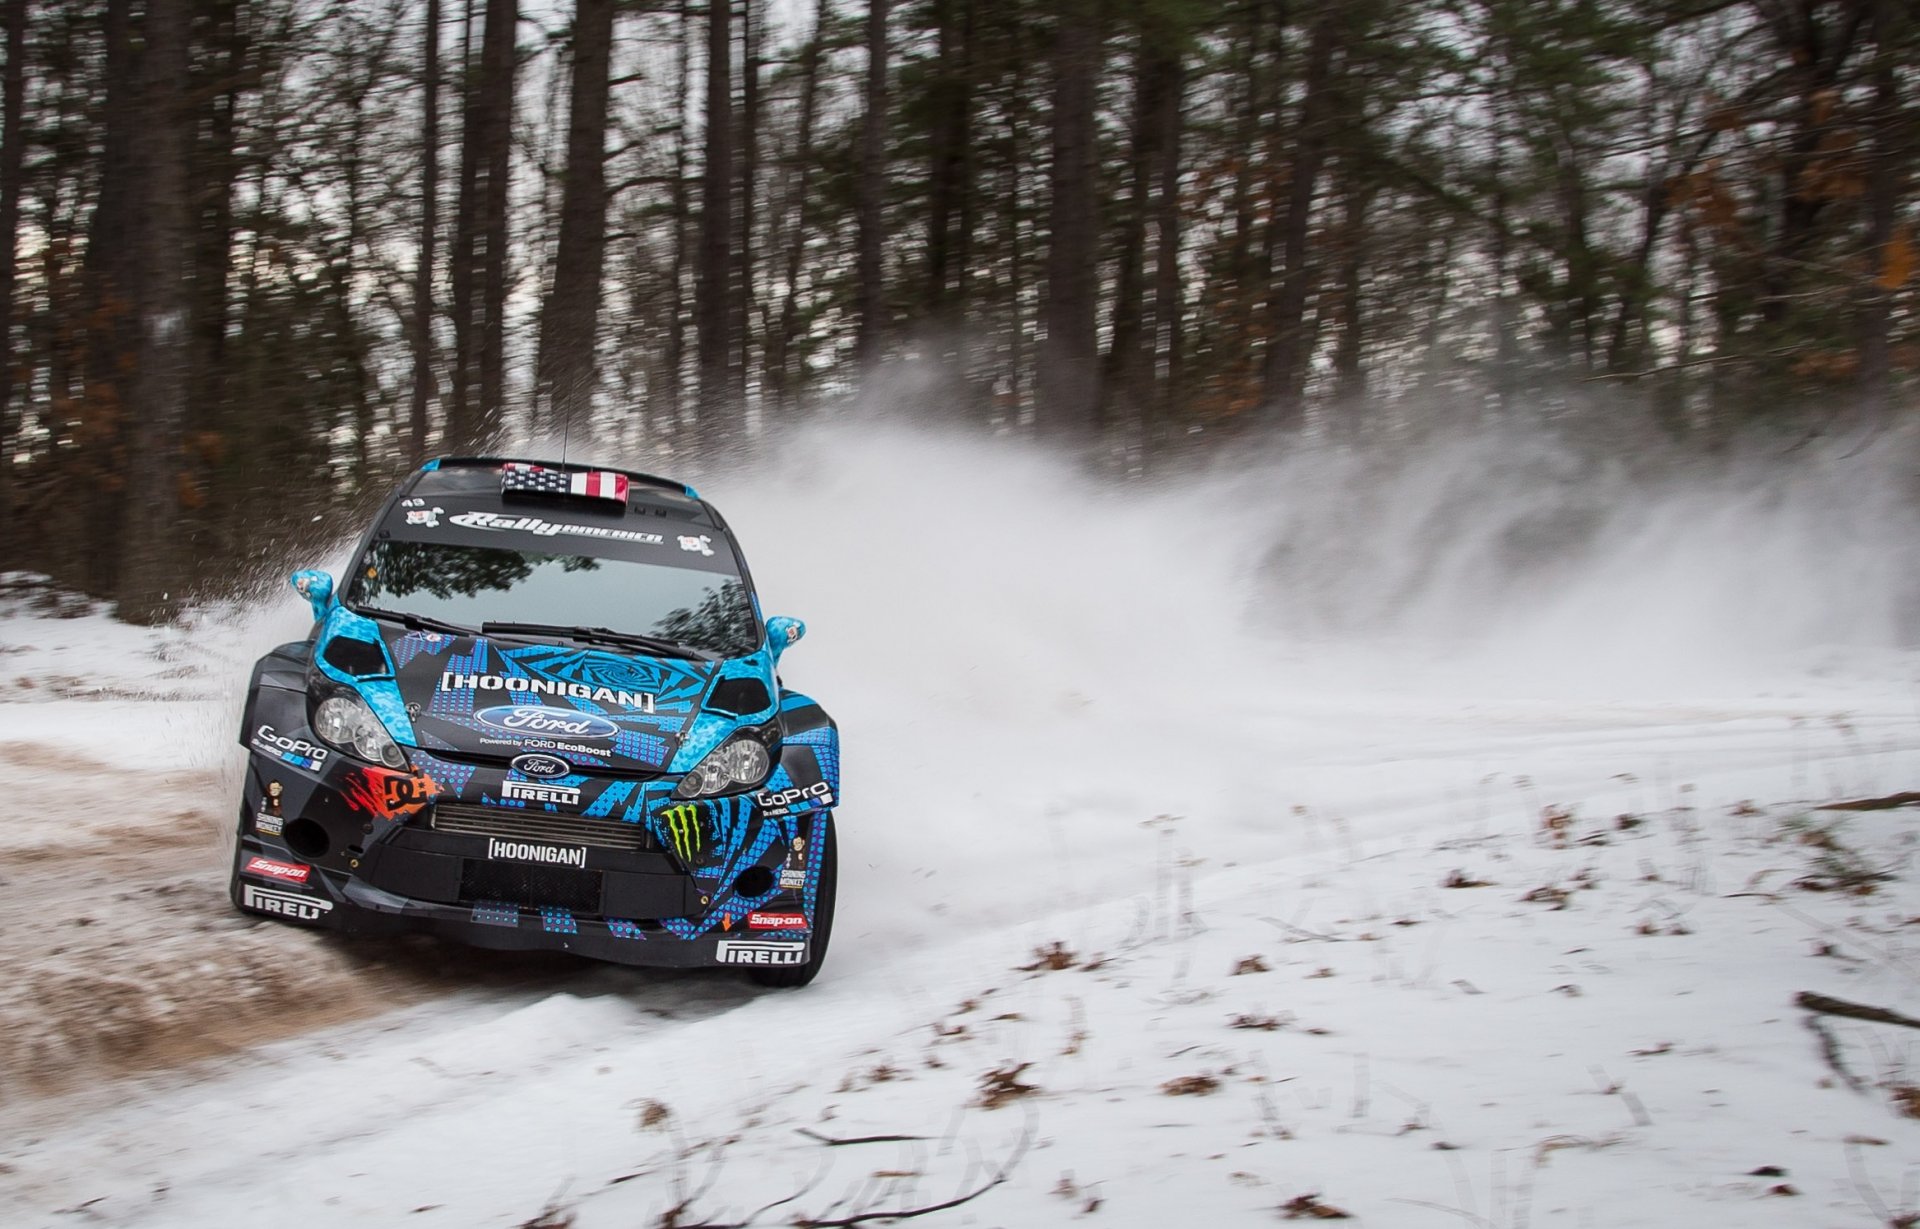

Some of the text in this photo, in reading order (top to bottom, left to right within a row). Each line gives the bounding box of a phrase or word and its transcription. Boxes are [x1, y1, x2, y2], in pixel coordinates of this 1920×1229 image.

[441, 672, 656, 714] [HOONIGAN]
[503, 707, 592, 735] Ford
[257, 725, 328, 760] GoPro
[480, 737, 612, 758] Powered by FORD EcoBoost
[524, 758, 555, 774] Ford
[502, 780, 581, 805] PIRELLI
[757, 782, 829, 806] GoPro
[488, 838, 587, 868] [HOONIGAN]
[251, 860, 307, 877] Snap-on
[751, 914, 803, 926] Snap-on
[716, 940, 806, 965] PIRELLI
